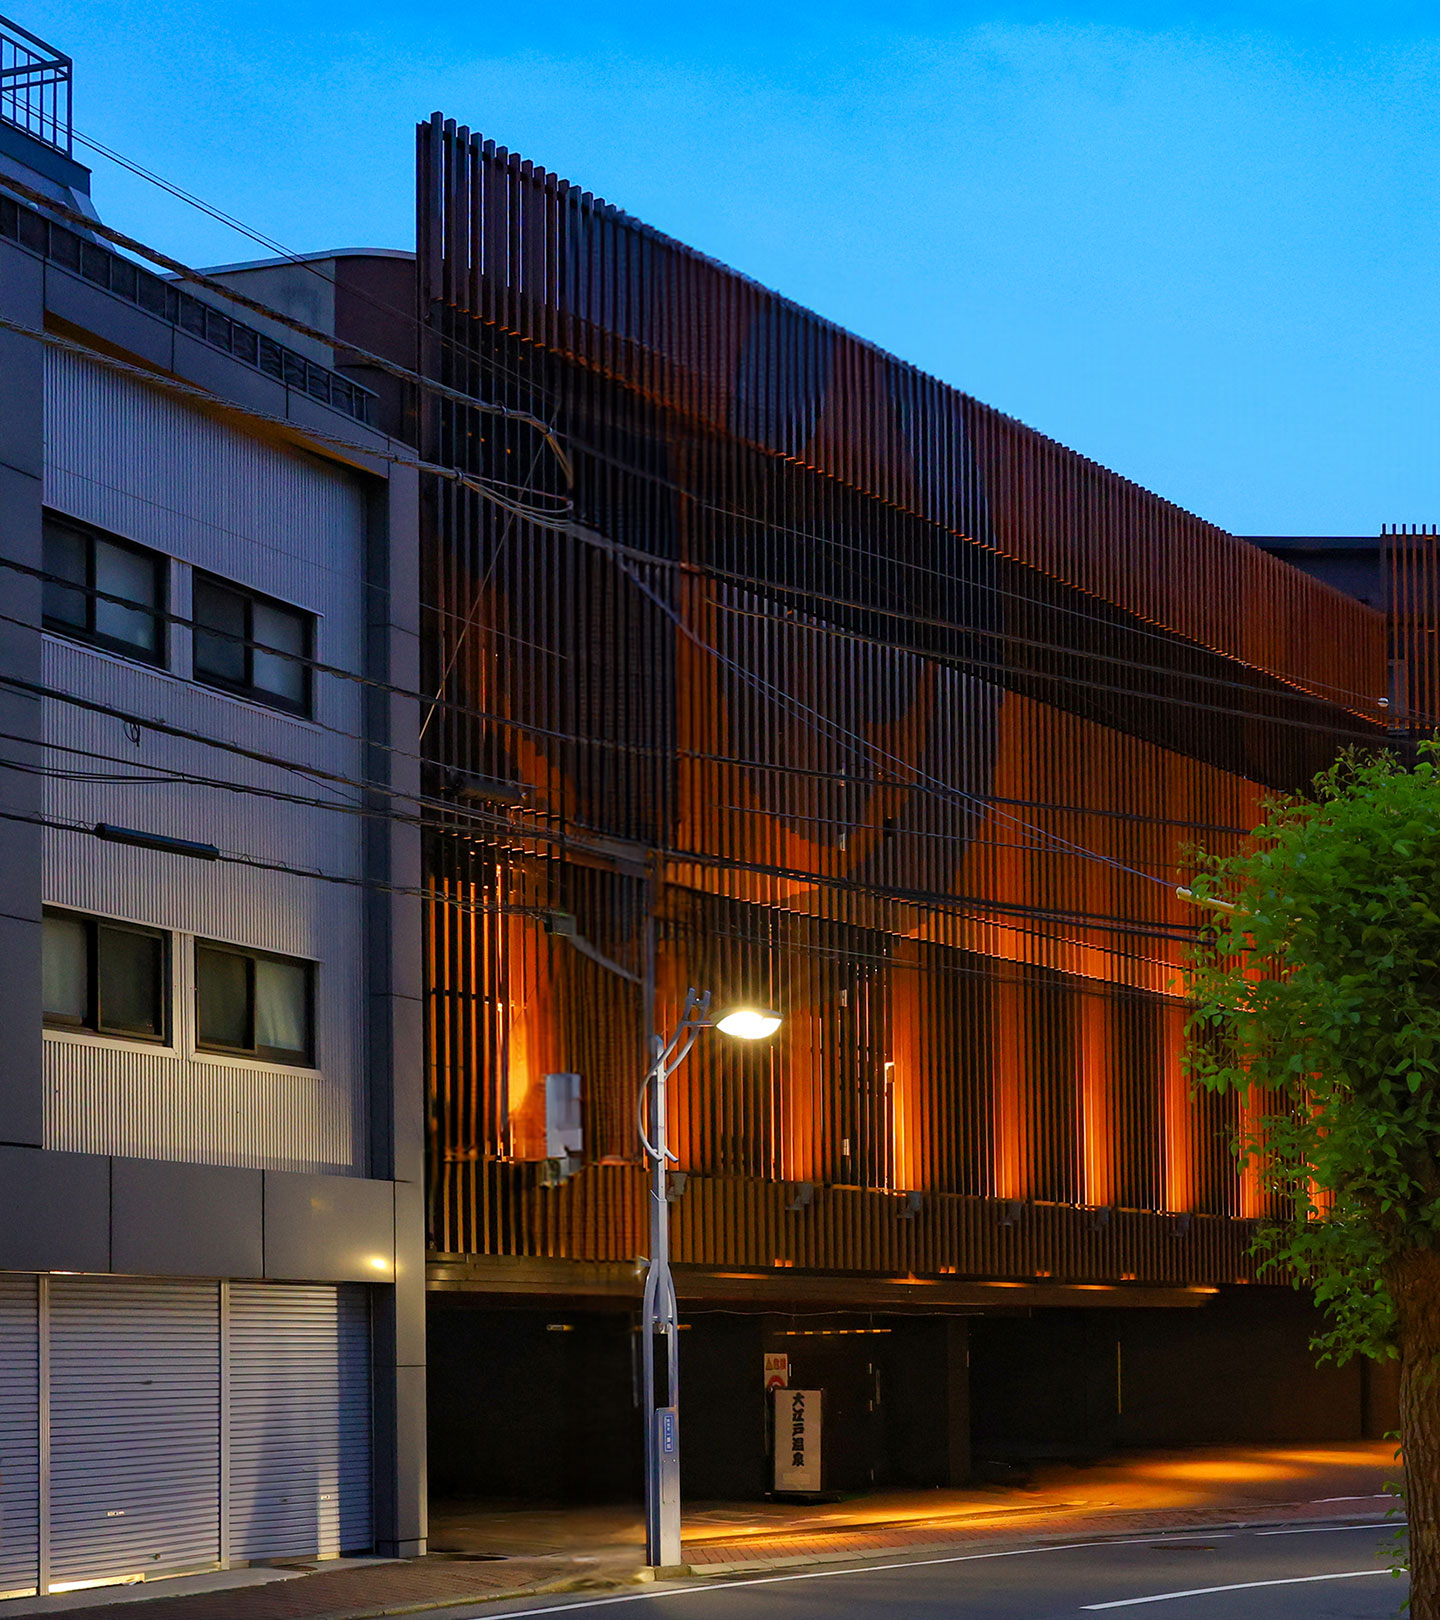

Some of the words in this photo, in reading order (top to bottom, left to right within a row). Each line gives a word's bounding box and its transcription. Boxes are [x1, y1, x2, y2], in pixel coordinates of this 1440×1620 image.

[792, 1392, 805, 1467] 大江戸温泉
